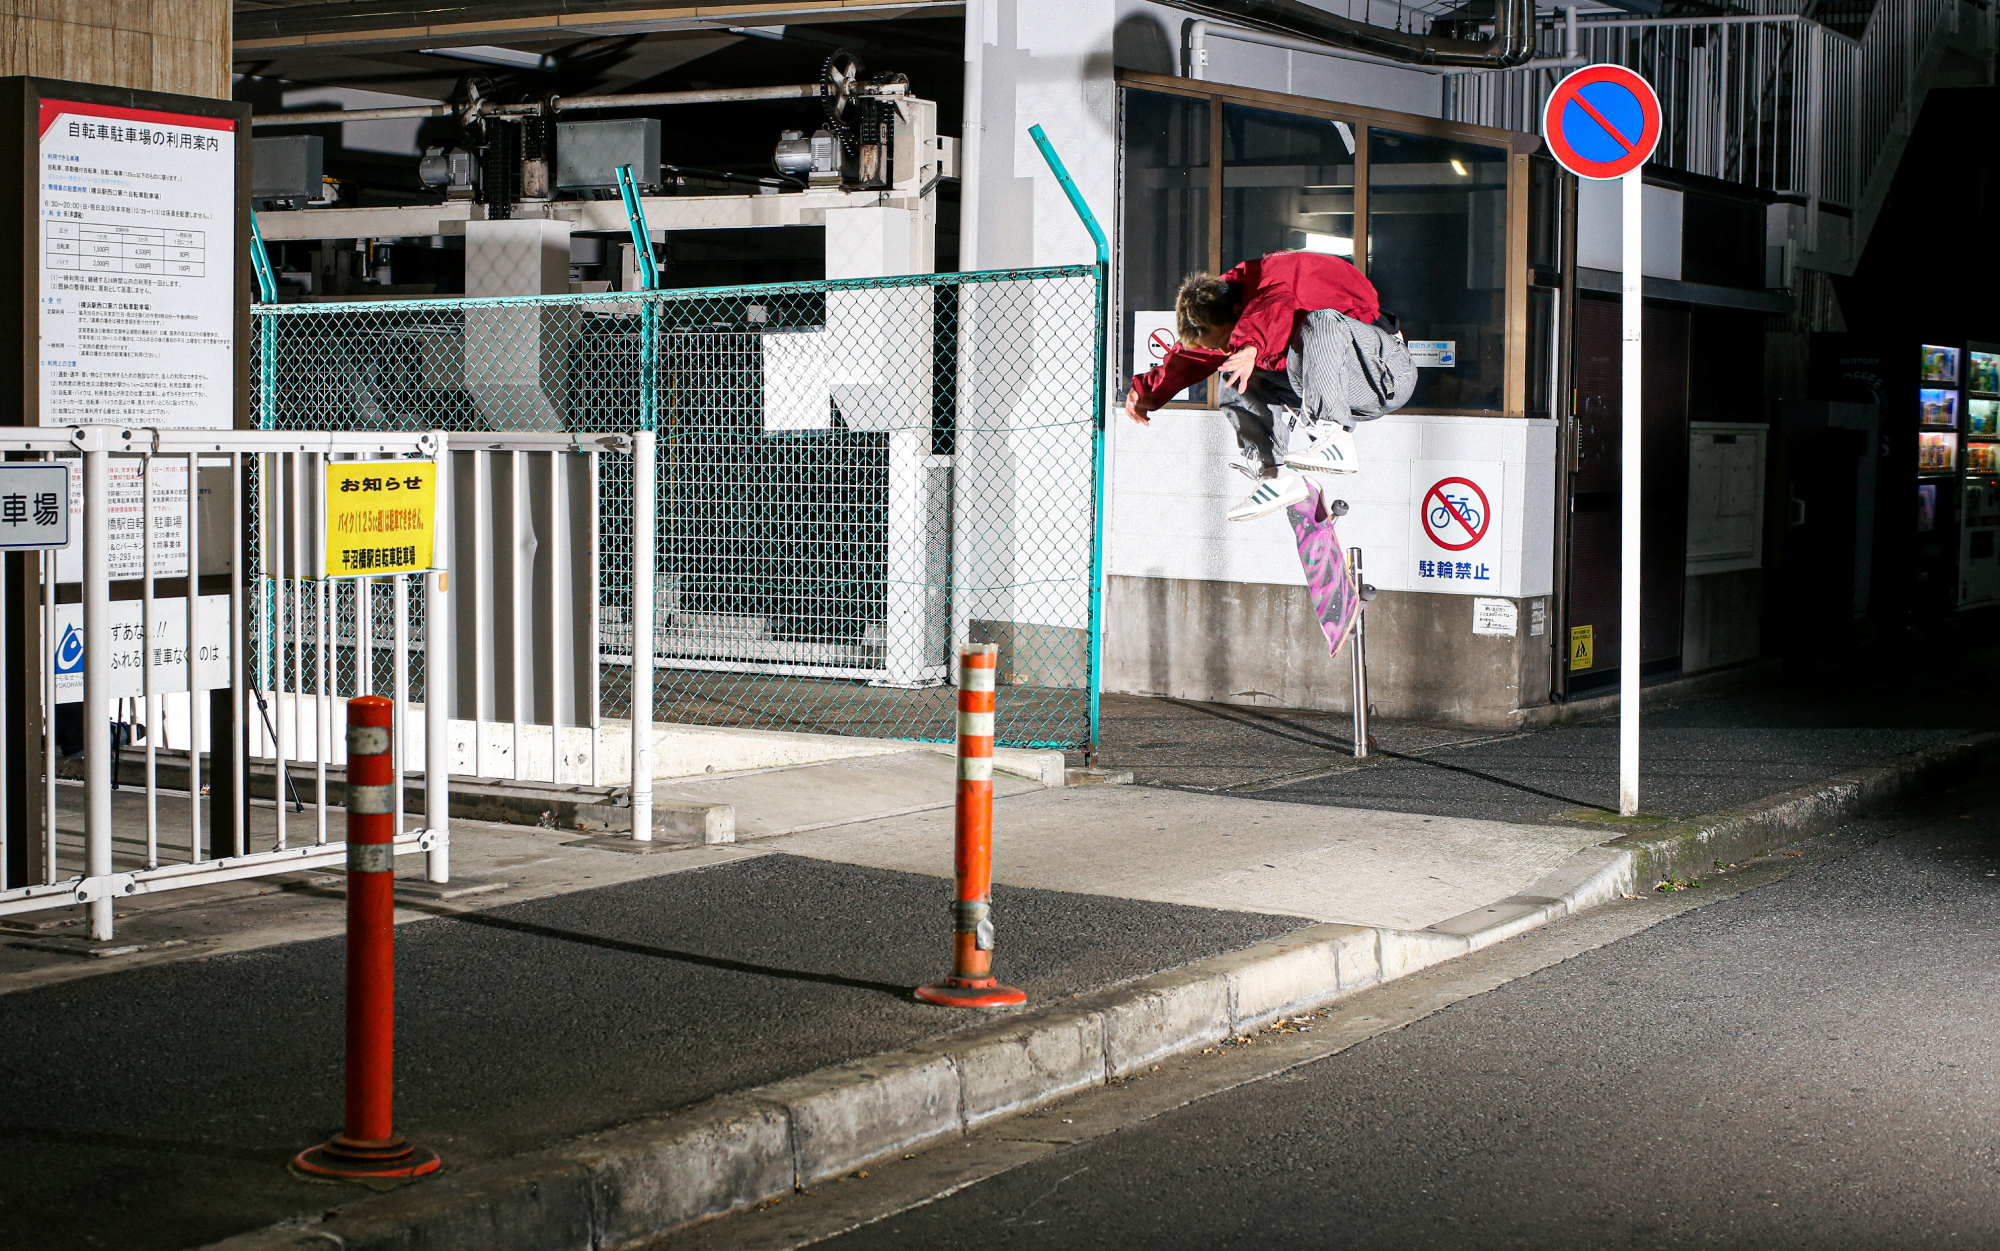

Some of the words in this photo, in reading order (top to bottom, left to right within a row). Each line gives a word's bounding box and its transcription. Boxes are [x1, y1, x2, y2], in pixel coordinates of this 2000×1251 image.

[68, 121, 219, 152] 自転車駐車場の利用案内
[93, 245, 110, 253] 1,500円
[93, 260, 110, 268] 2,000円
[135, 262, 152, 270] 6,000円
[340, 476, 422, 492] お知らせ
[2, 492, 59, 527] 車場
[342, 545, 415, 570] 平沼橋駅自転車駐車場
[1418, 560, 1490, 581] 駐輪禁止
